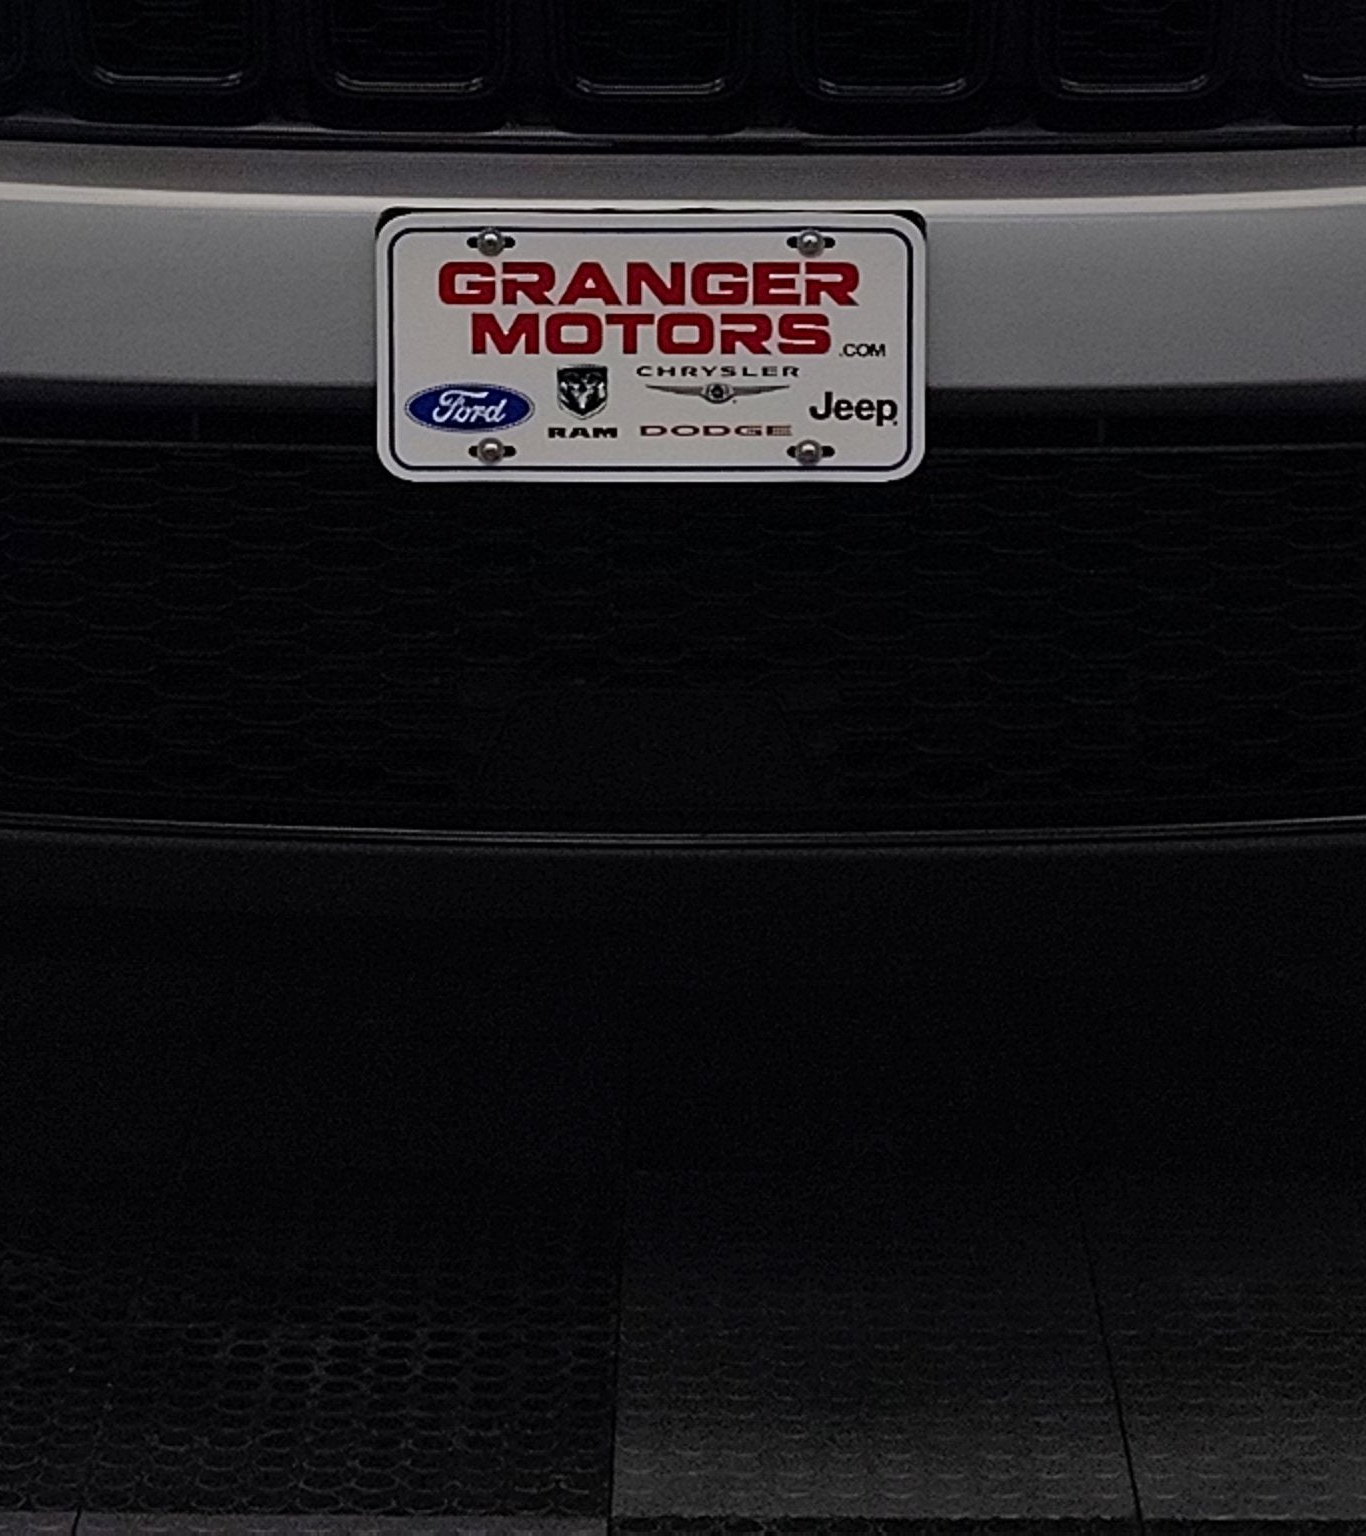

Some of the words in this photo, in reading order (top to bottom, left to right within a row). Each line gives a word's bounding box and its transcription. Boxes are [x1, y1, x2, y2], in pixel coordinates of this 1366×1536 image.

[438, 262, 860, 306] GRANGER
[471, 312, 832, 355] MOTORS
[636, 366, 800, 378] CHRYSLER
[432, 390, 509, 424] Ford
[809, 392, 898, 427] Jeep
[548, 427, 618, 439] RAM
[639, 425, 794, 438] DODGE
